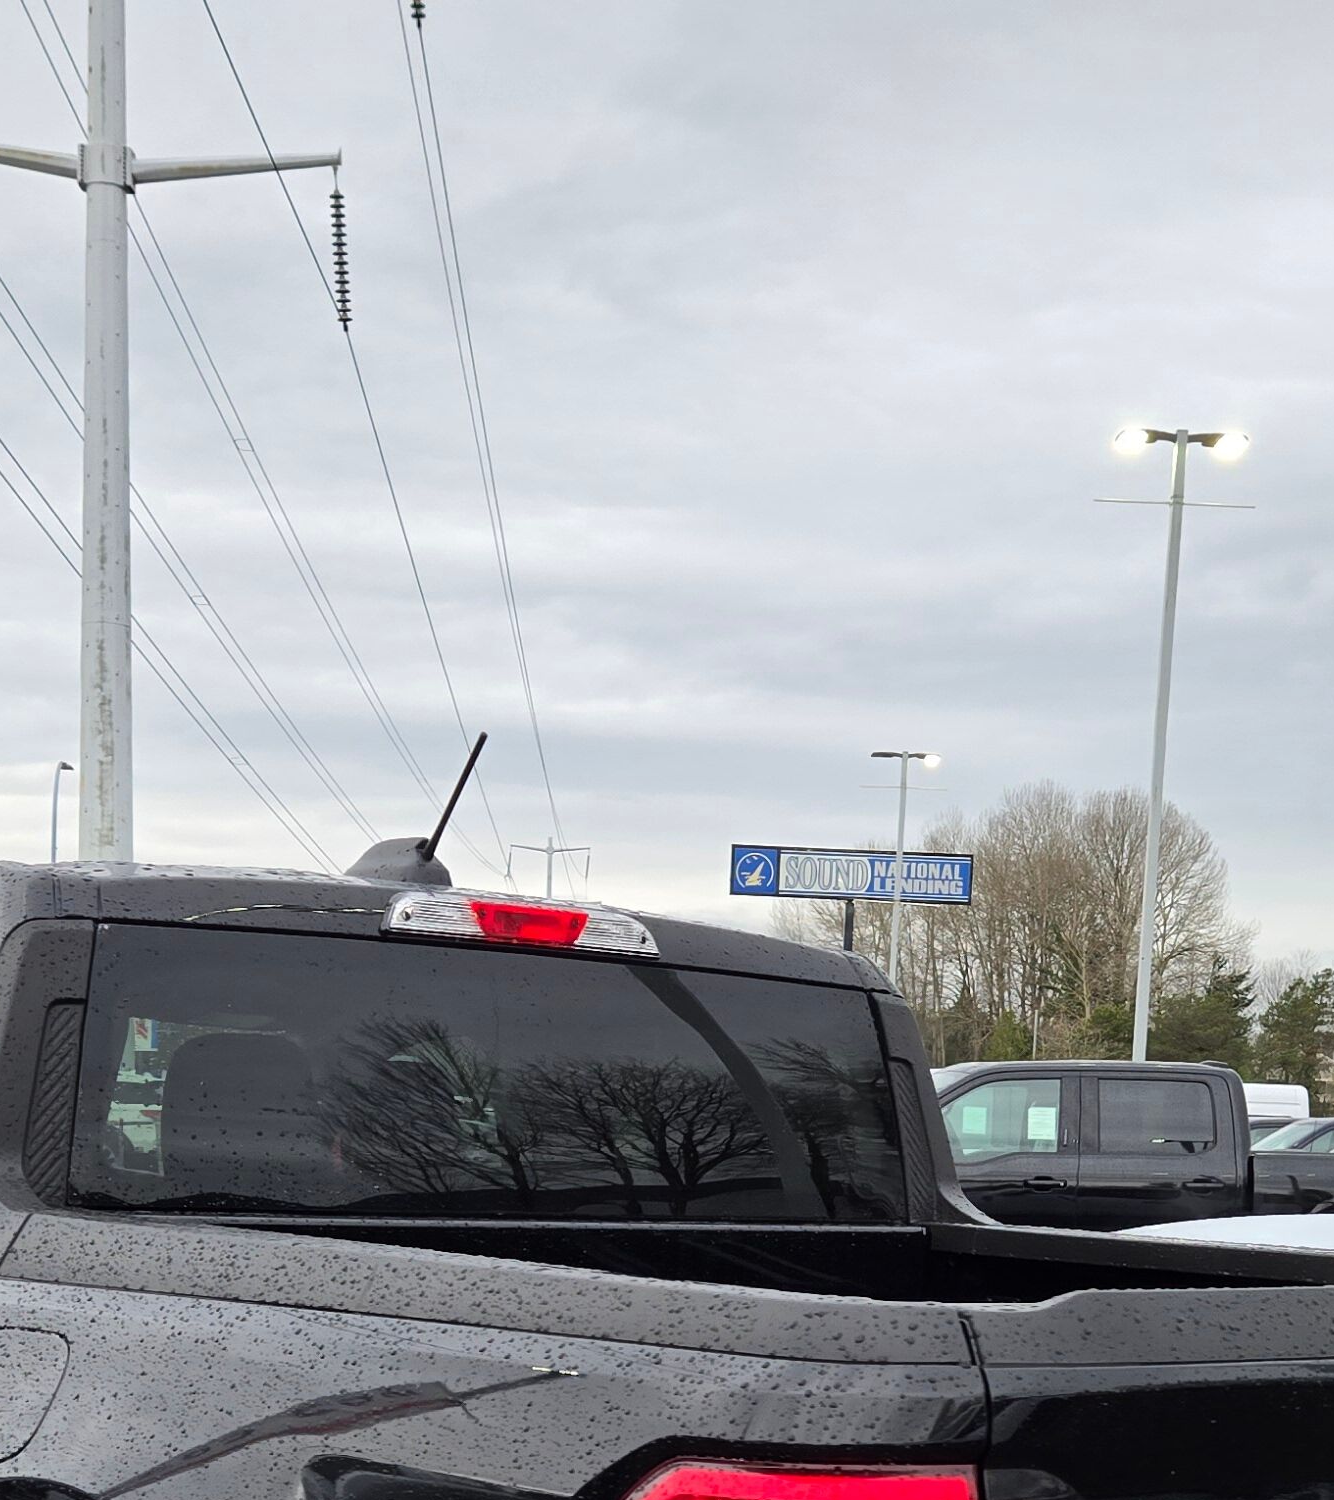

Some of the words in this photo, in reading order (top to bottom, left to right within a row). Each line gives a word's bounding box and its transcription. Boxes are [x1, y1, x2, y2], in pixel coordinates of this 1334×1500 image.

[785, 856, 868, 891] SOUND
[874, 861, 962, 880] NATIONAL
[873, 877, 963, 896] LENDING
